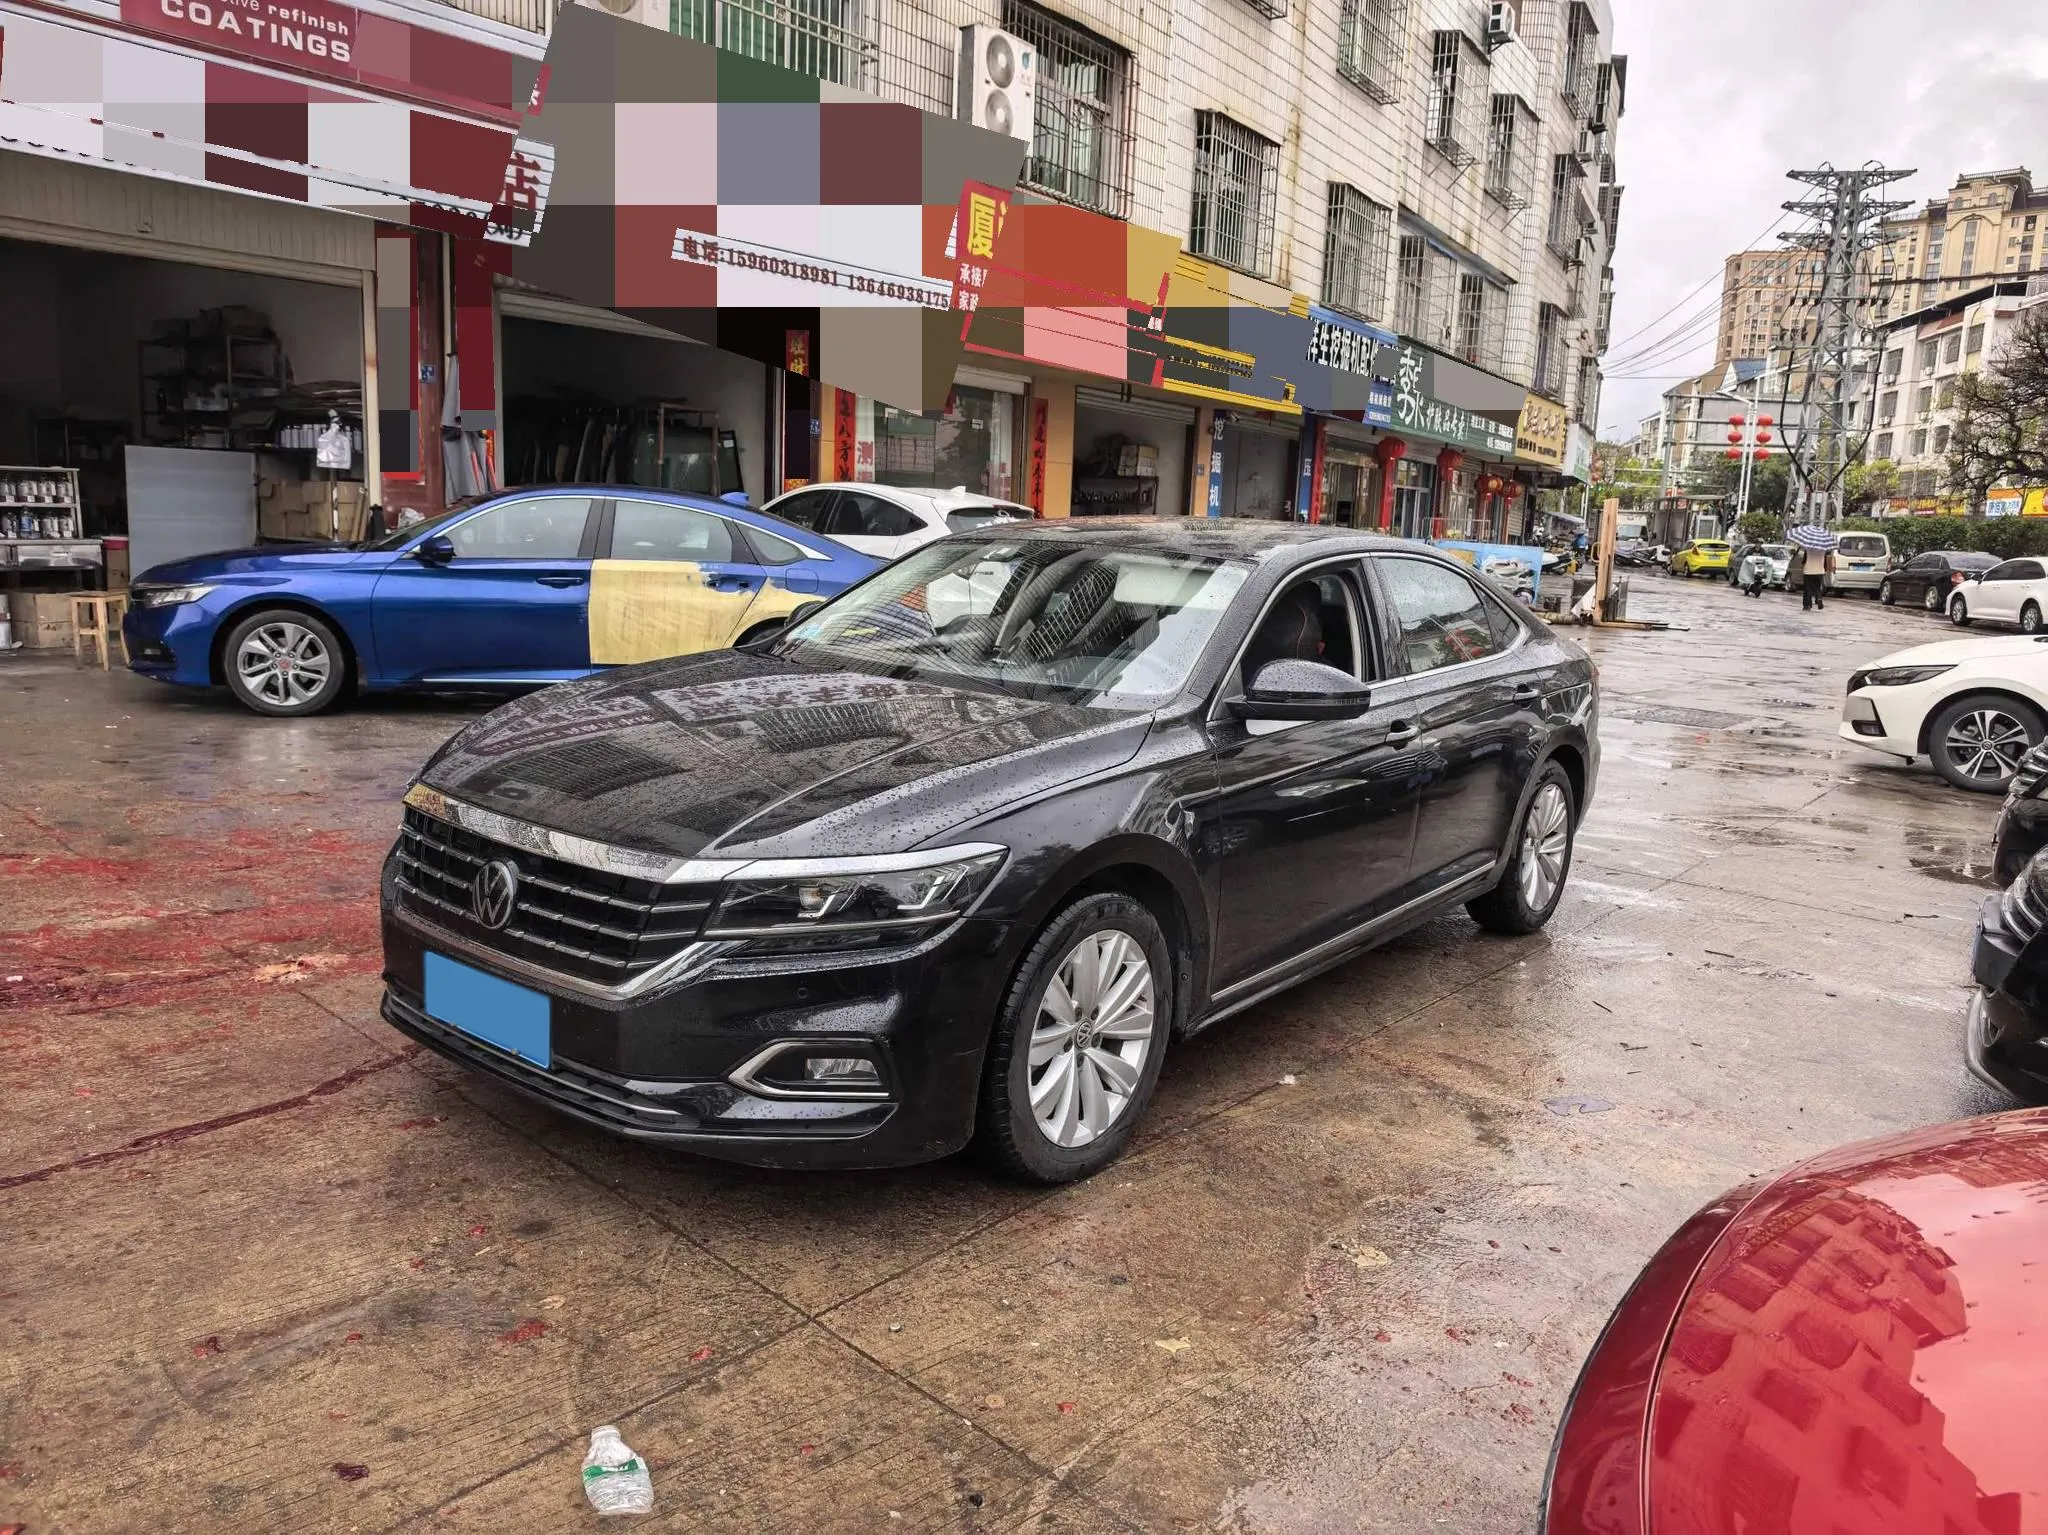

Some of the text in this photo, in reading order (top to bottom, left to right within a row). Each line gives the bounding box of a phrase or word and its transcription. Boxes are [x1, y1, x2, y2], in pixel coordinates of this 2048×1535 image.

[161, 0, 351, 63] COATINGS
[268, 5, 349, 35] refinish
[848, 274, 949, 309] 13646938175
